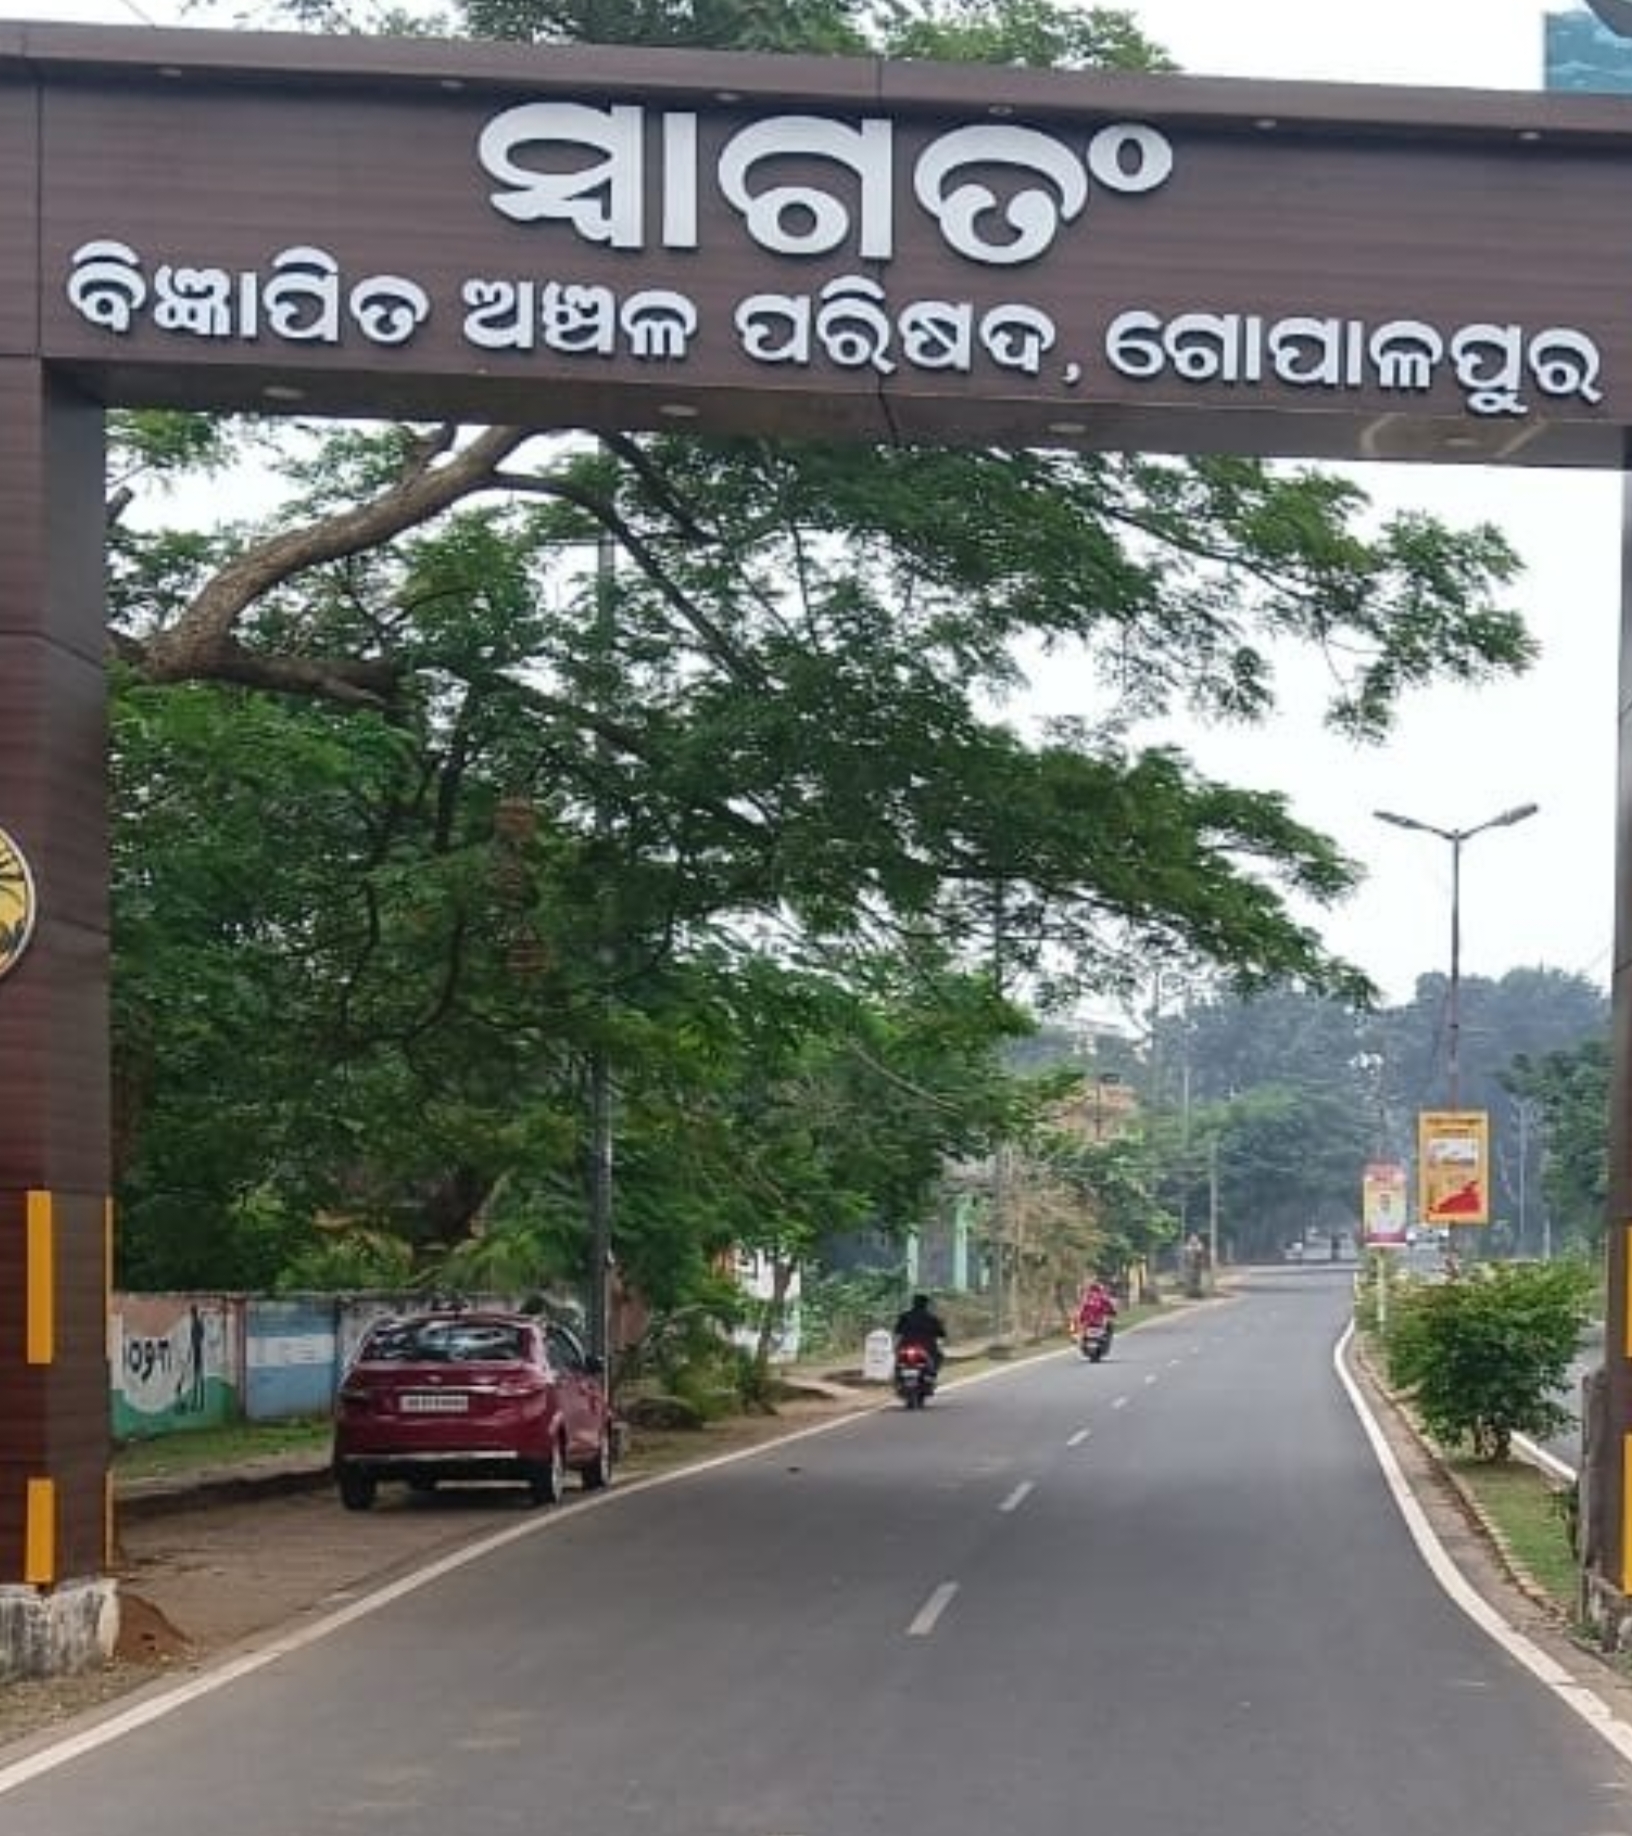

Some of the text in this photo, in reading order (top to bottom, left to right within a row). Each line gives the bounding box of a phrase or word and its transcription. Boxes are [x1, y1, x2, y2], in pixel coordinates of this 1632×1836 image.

[67, 240, 429, 342] ବିଜ୍ଞାପିତ
[462, 279, 697, 356] ଅଞ୍ଚଳ
[1105, 310, 1602, 413] ଗୋପାଳପୁର
